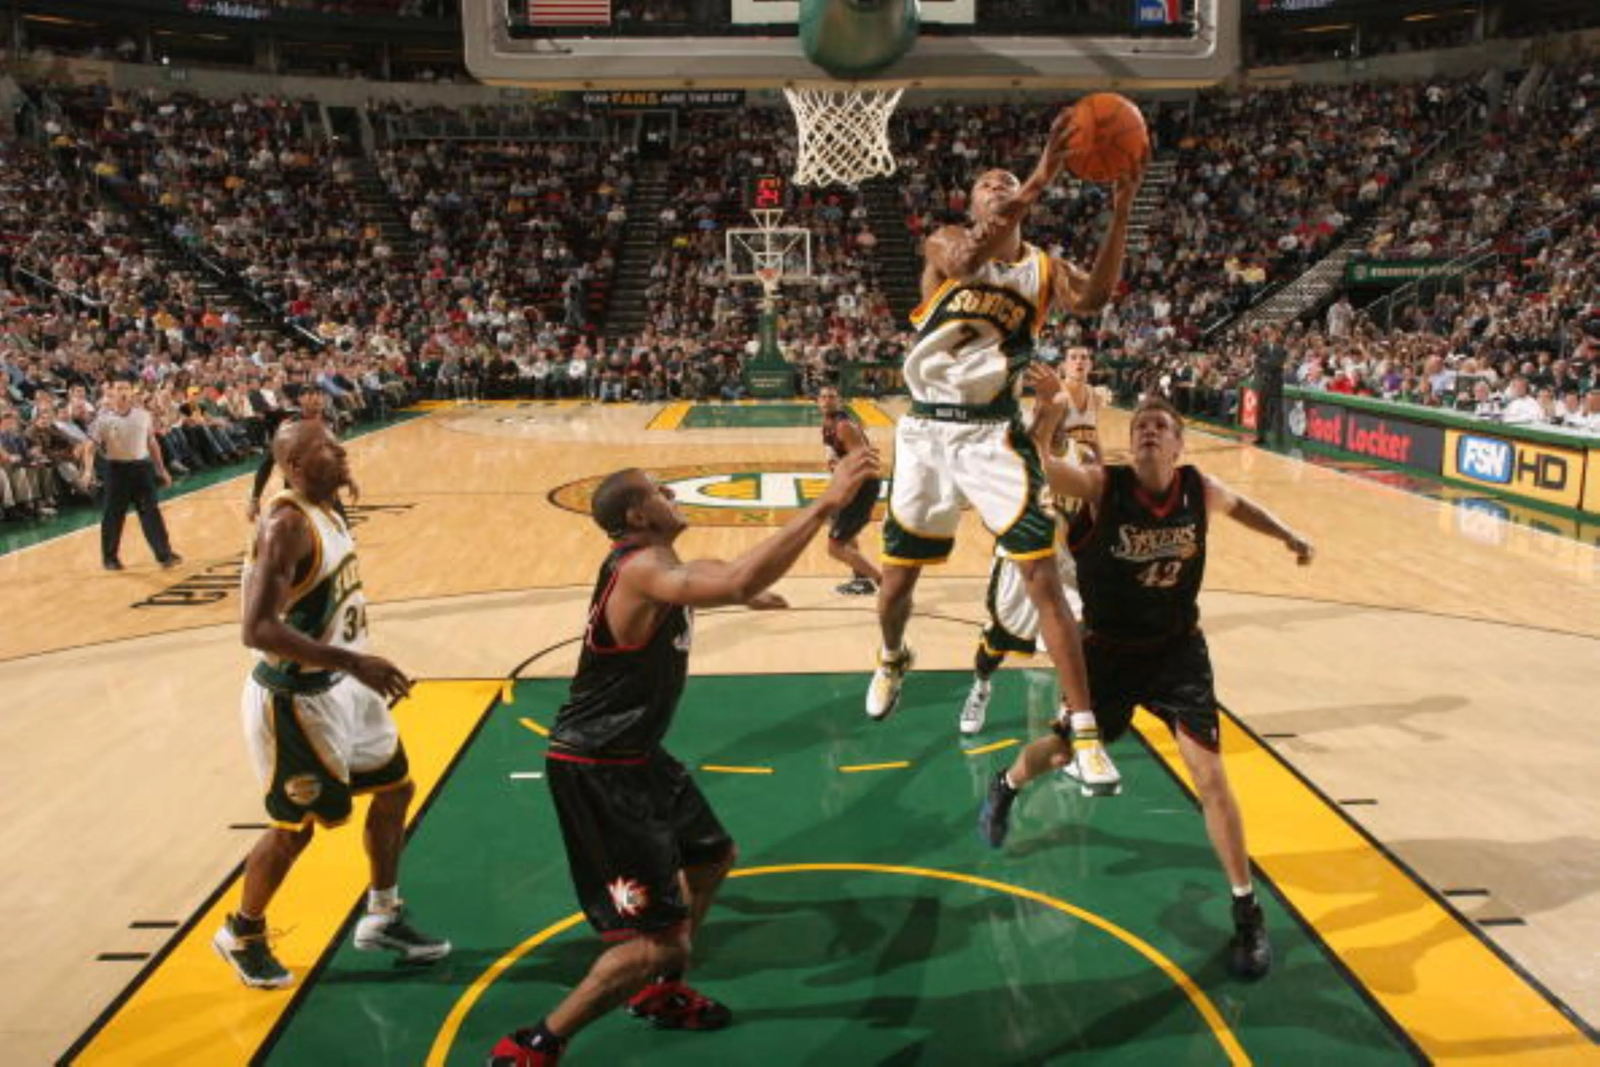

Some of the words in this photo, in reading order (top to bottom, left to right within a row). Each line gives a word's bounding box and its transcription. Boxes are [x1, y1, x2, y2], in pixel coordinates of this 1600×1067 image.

[612, 92, 659, 105] FANS
[946, 288, 1027, 331] SONICS
[1348, 415, 1412, 462] Locker
[1464, 437, 1508, 478] FSN
[1517, 448, 1567, 492] HD
